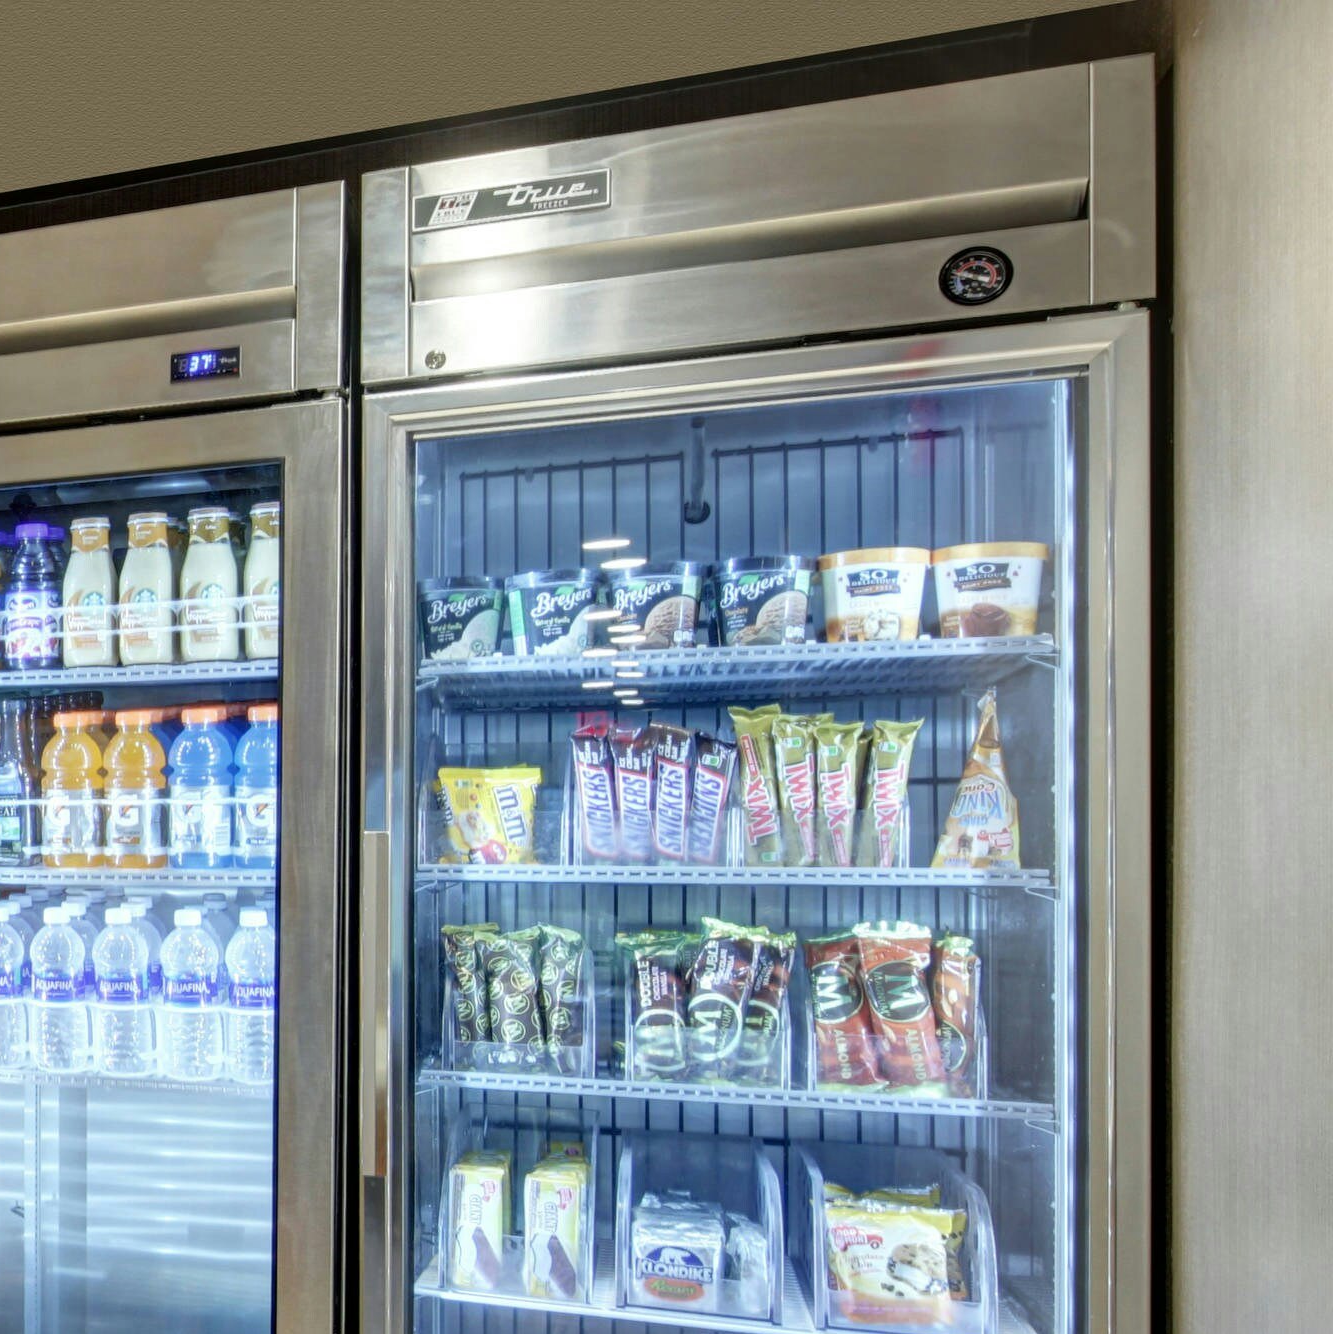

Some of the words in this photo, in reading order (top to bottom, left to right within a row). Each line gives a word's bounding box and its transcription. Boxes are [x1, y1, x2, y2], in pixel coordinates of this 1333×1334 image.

[534, 200, 568, 209] FREEZER
[860, 568, 888, 580] SO
[966, 563, 995, 575] SO
[531, 587, 592, 616] Breyers
[613, 579, 673, 610] Breyers
[720, 573, 788, 608] Breyers
[427, 594, 487, 623] Breyers
[874, 760, 906, 830] TWIX
[658, 766, 683, 855] SNICKERS
[35, 977, 74, 991] AQUAFINA
[99, 980, 140, 993] AQUAFINA
[833, 1029, 852, 1080] ALMOND
[905, 1028, 926, 1081] ALMOND
[471, 1193, 483, 1225] GIANT
[545, 1201, 558, 1234] GIANT
[636, 1258, 713, 1283] KLONDIKE
